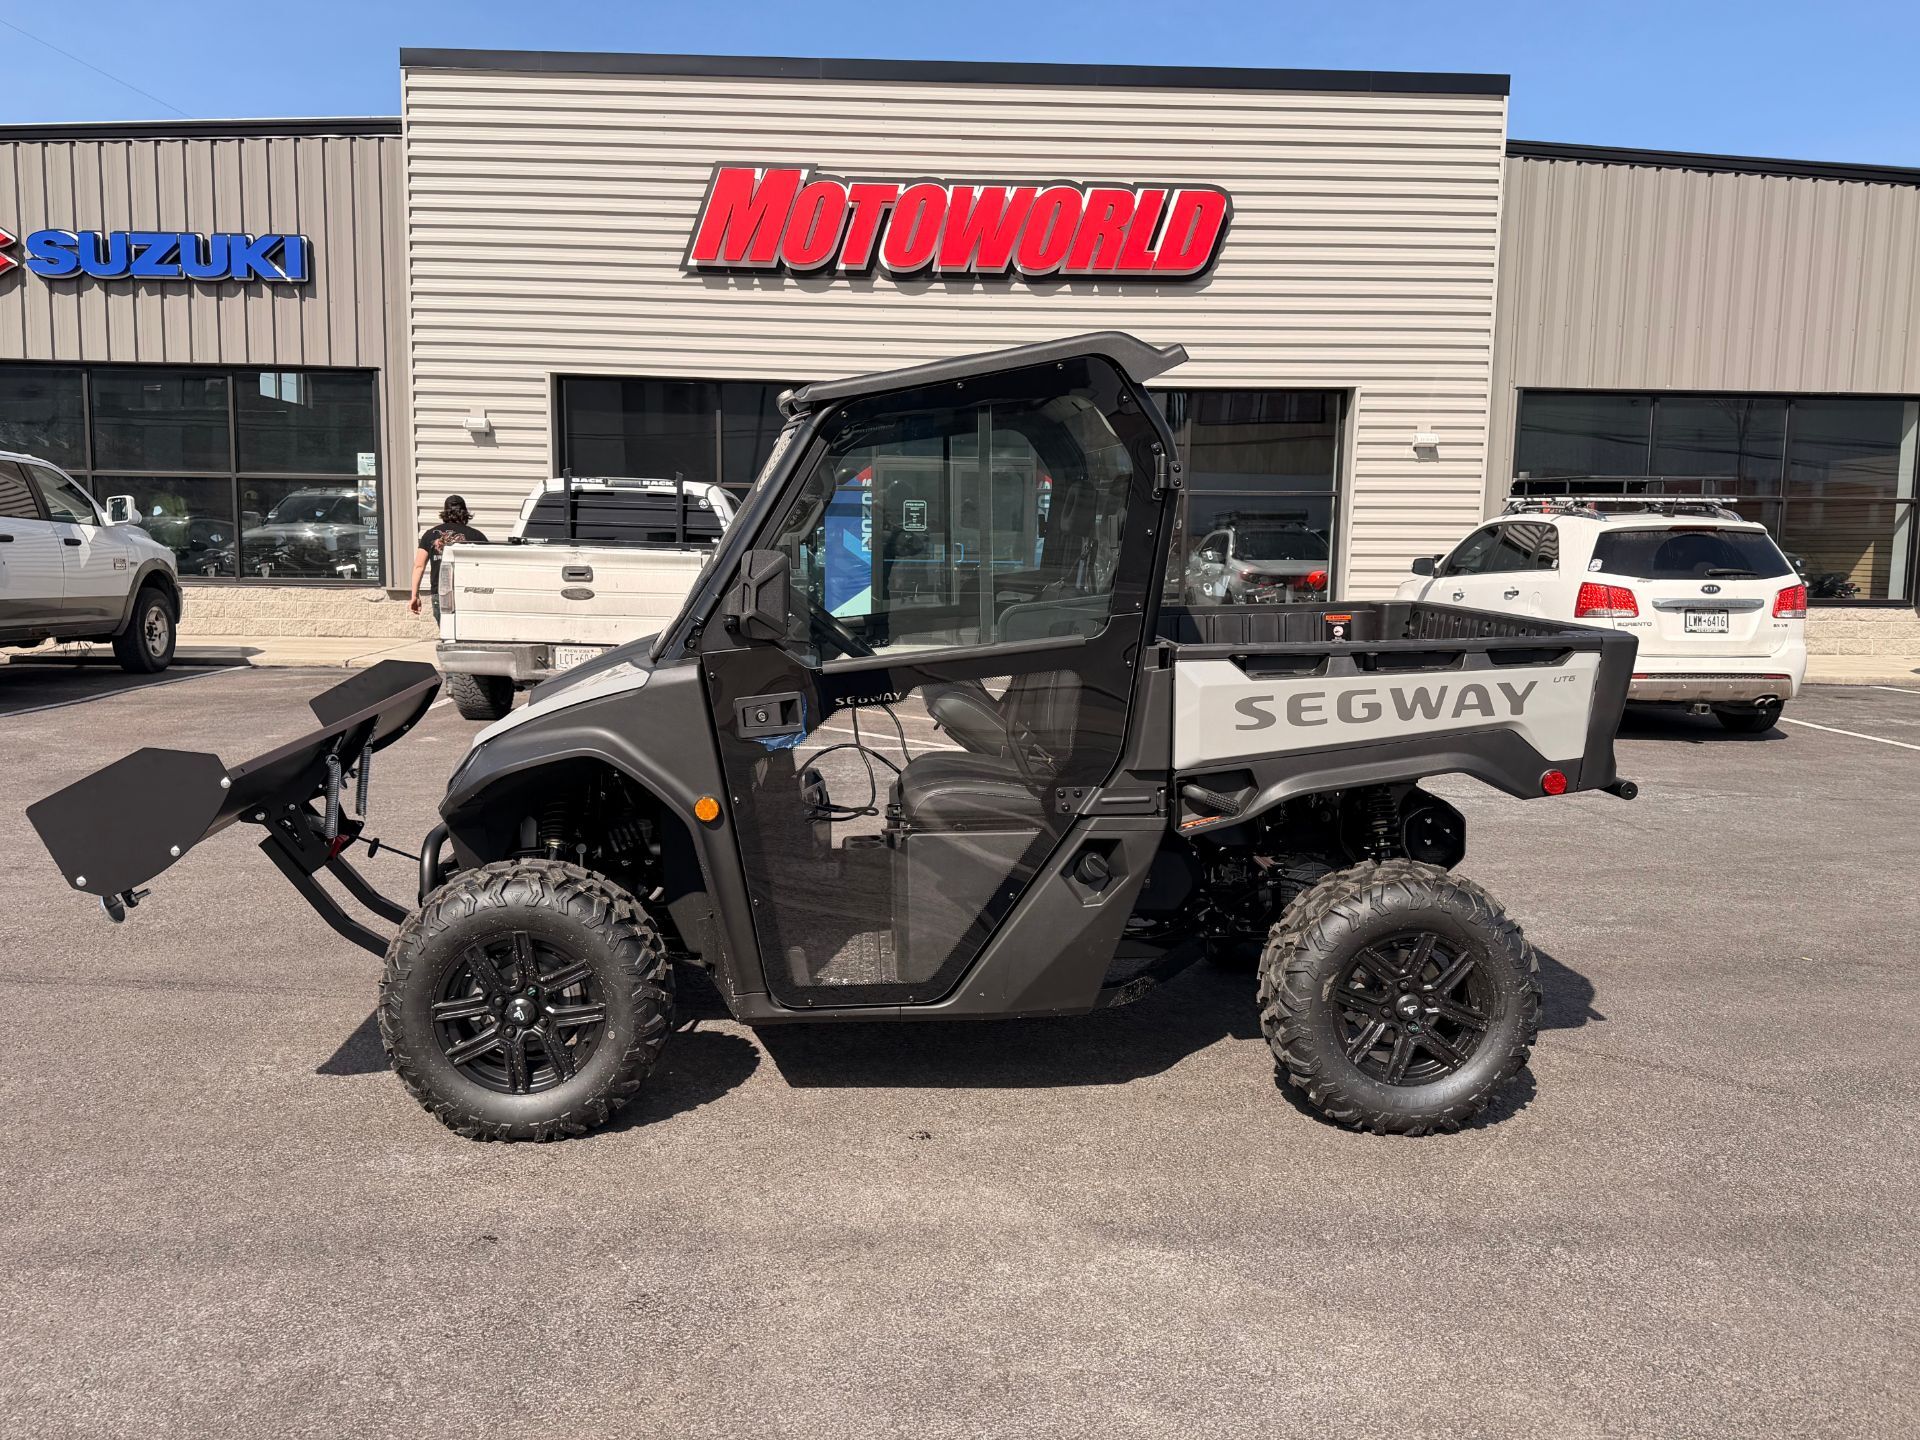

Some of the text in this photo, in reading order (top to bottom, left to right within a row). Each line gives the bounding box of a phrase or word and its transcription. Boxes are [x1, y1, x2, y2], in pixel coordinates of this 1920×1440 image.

[688, 165, 1229, 274] MOTOWORLD
[25, 229, 309, 281] SUZUKI
[1553, 674, 1577, 683] UT6
[1234, 680, 1538, 731] SEGWAY
